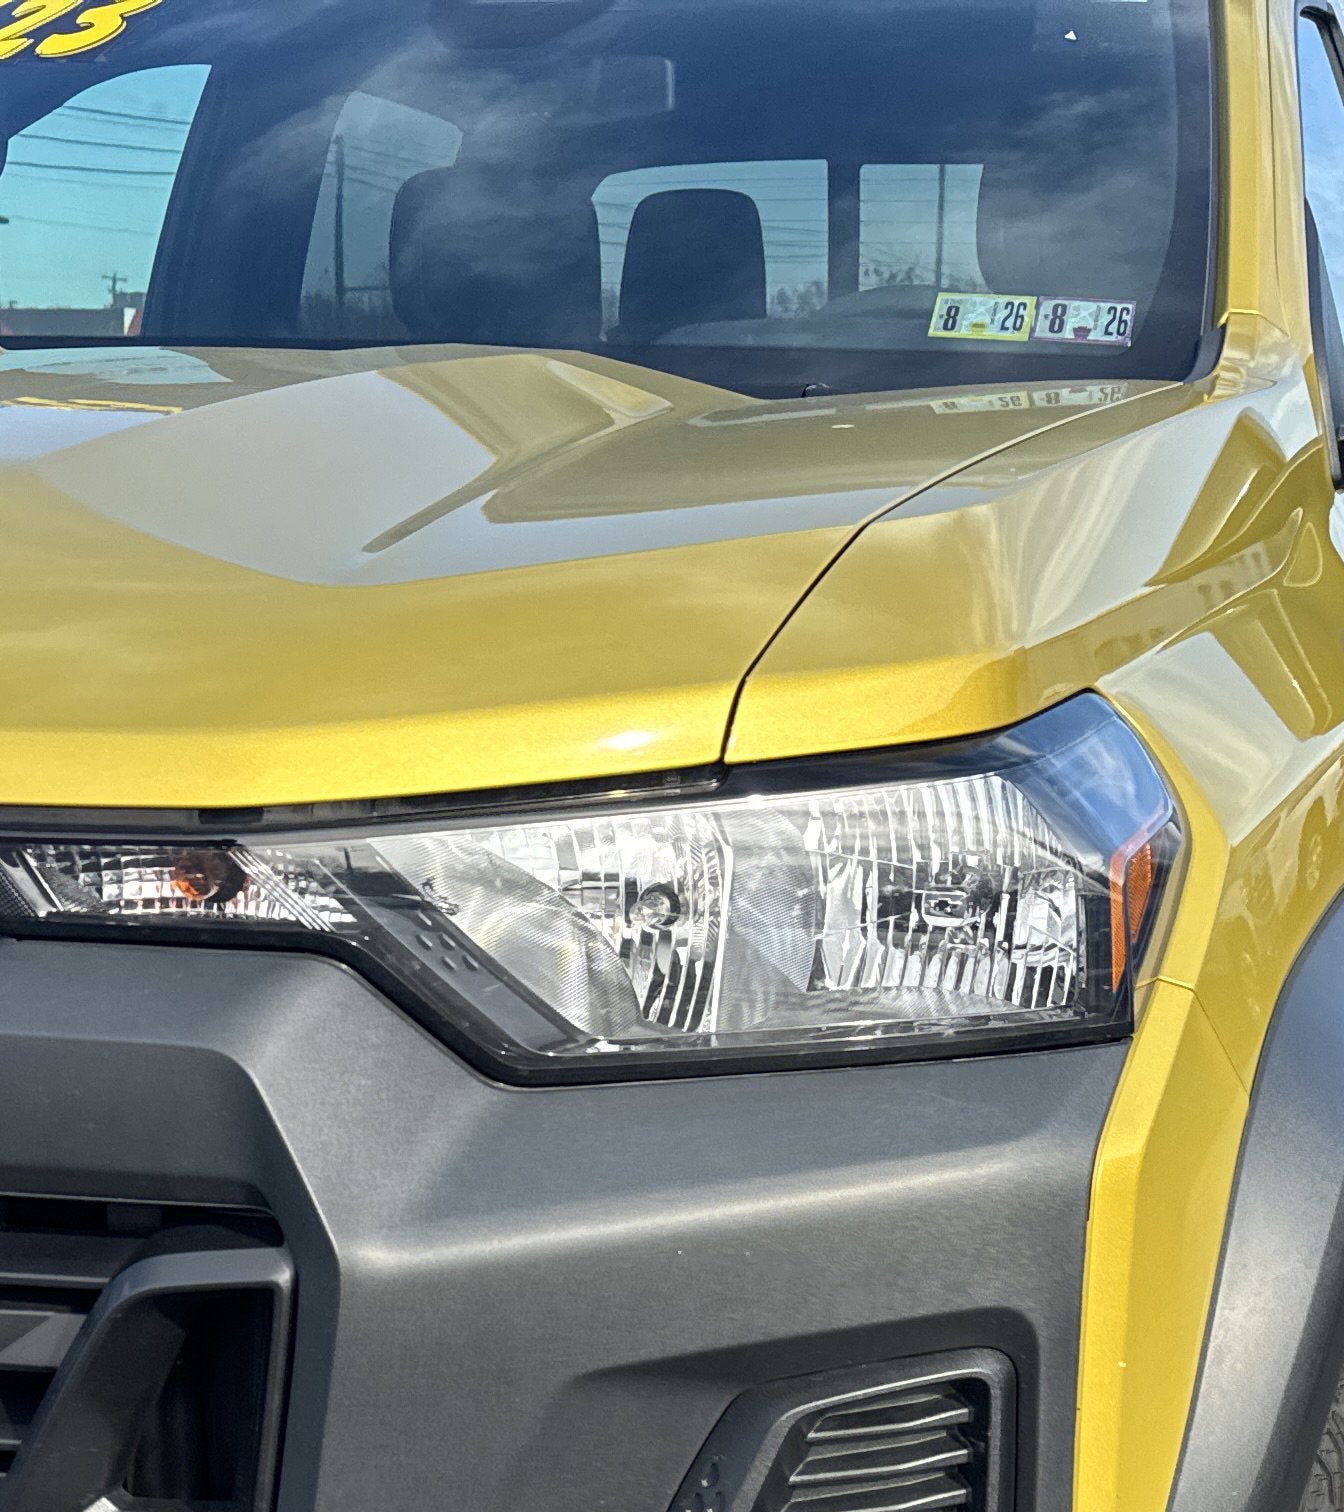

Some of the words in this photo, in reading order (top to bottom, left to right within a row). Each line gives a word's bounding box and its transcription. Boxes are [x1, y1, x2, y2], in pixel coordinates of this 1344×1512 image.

[942, 305, 960, 331] 8
[1000, 301, 1028, 332] 26
[1048, 303, 1067, 334] 8
[1104, 306, 1130, 337] 26
